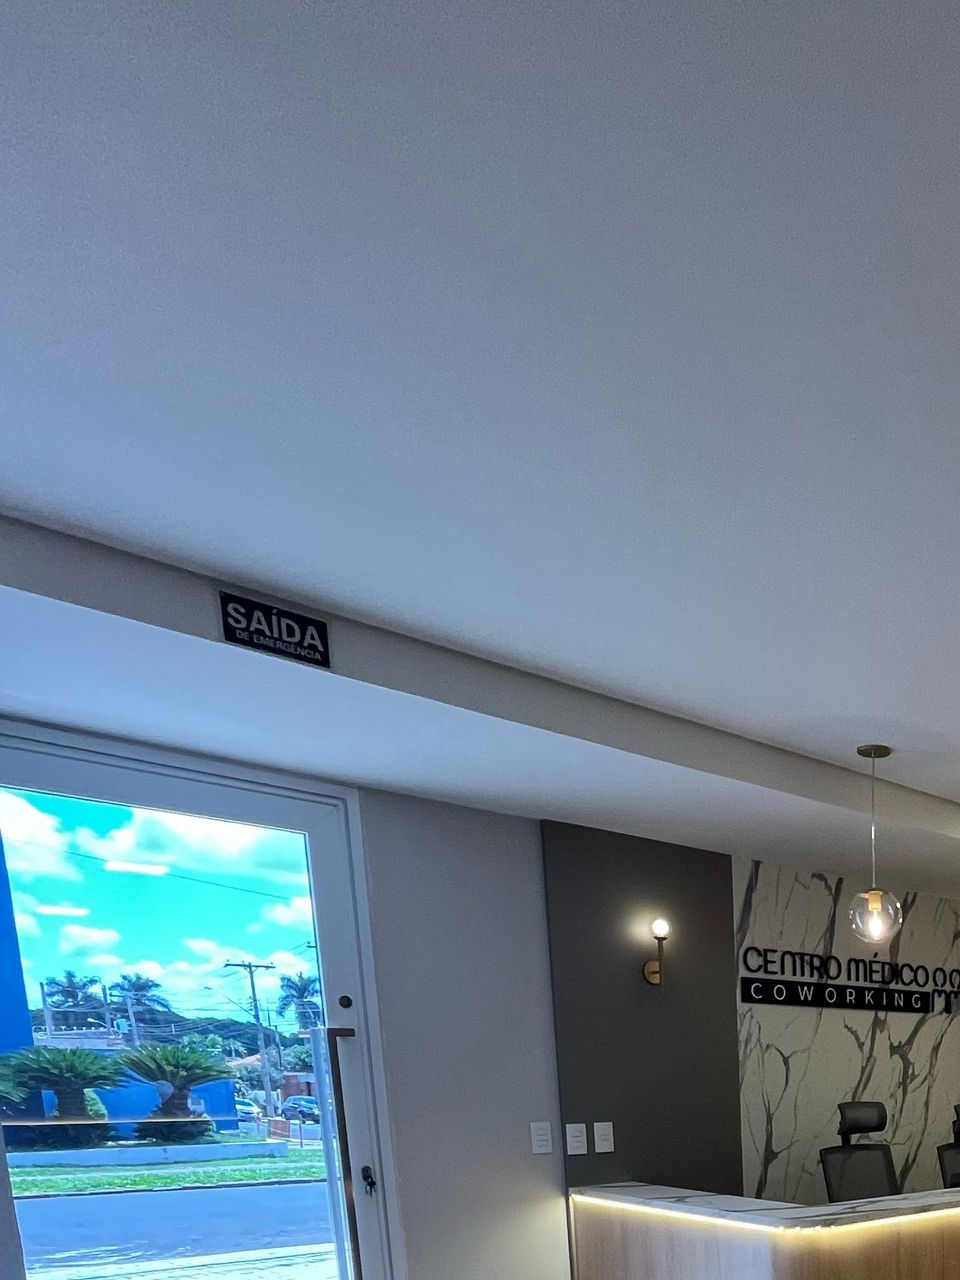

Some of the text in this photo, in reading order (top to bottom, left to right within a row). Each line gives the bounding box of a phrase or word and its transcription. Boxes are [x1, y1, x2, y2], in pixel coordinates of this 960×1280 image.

[227, 603, 324, 652] SAÍDA
[236, 630, 250, 641] DE
[743, 946, 929, 987] CENTRO MÉDICO
[751, 983, 921, 1008] COWORKING
